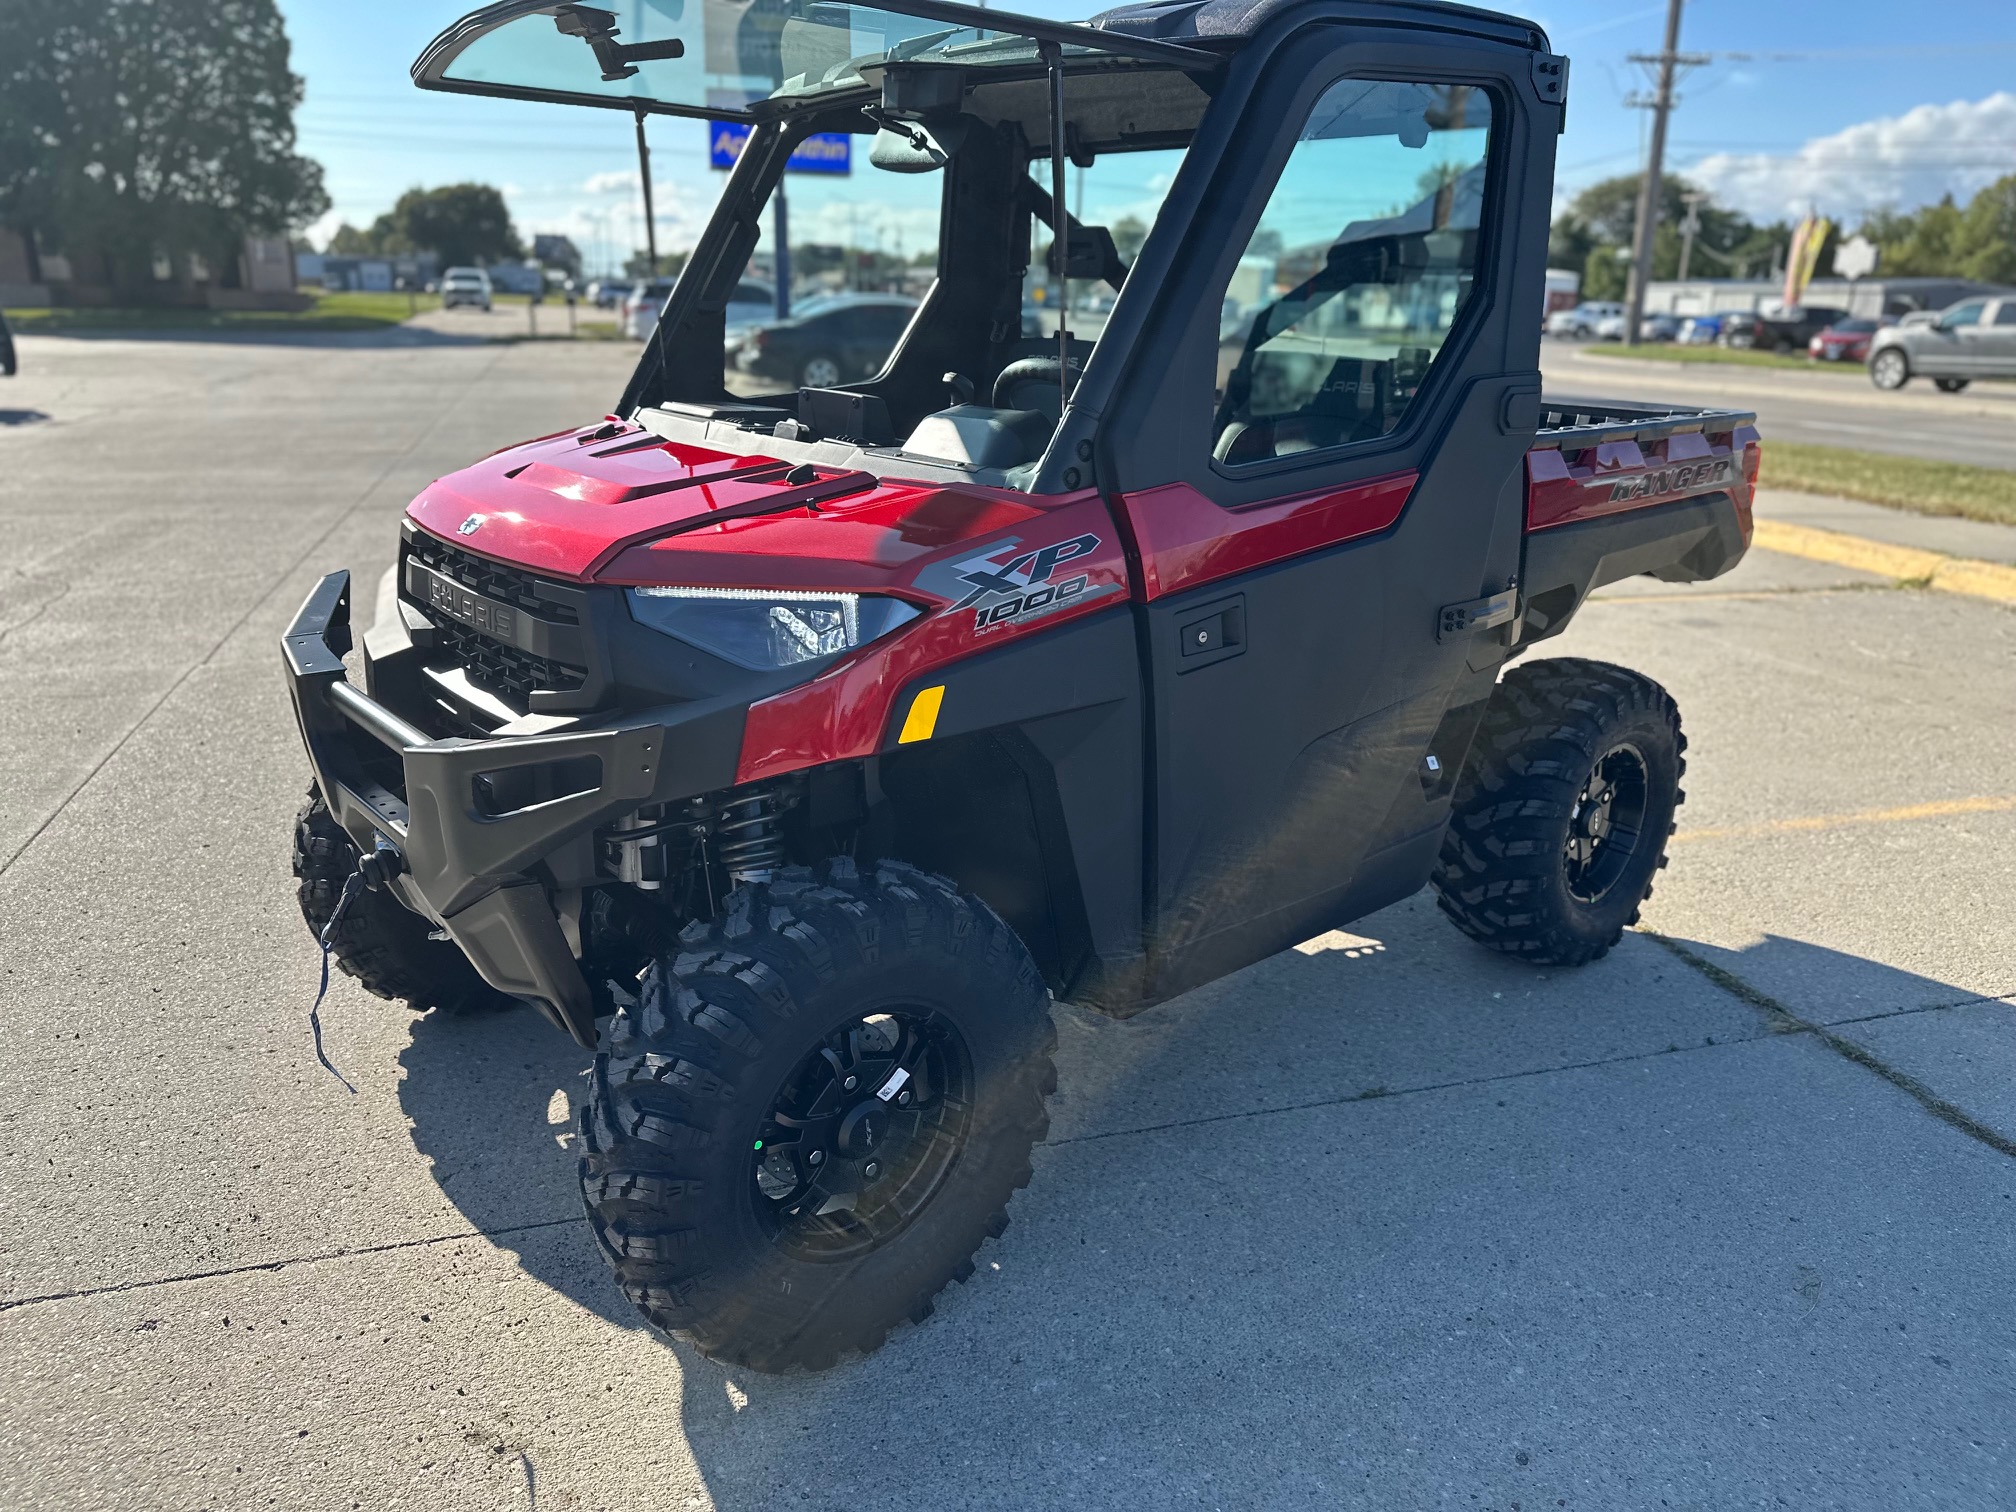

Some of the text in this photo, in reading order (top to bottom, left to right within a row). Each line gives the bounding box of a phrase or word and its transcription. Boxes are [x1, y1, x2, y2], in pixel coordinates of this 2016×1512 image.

[1608, 460, 1729, 503] RANGER
[935, 533, 1102, 619] XP
[974, 574, 1088, 630] 1000
[430, 577, 511, 638] POLARIS
[974, 595, 1083, 637] DUAL OVERHEAD CAM
